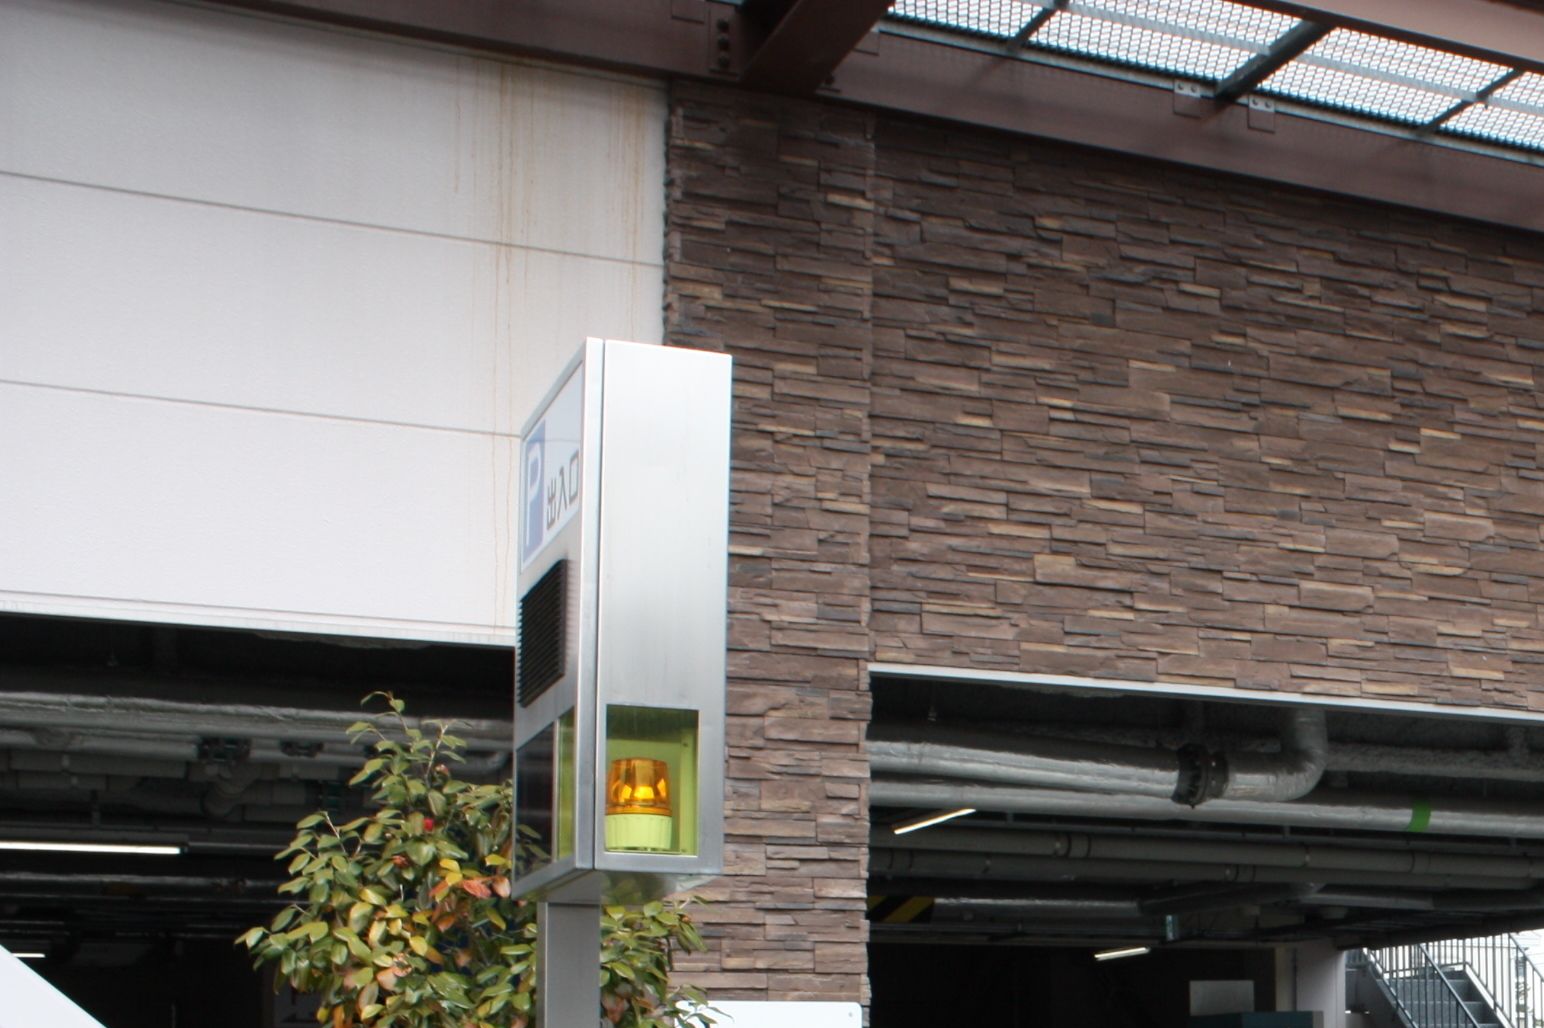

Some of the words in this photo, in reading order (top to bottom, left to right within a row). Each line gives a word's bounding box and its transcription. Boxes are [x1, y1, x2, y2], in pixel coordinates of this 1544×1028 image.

[525, 440, 542, 548] P
[546, 450, 580, 531] 出入口
